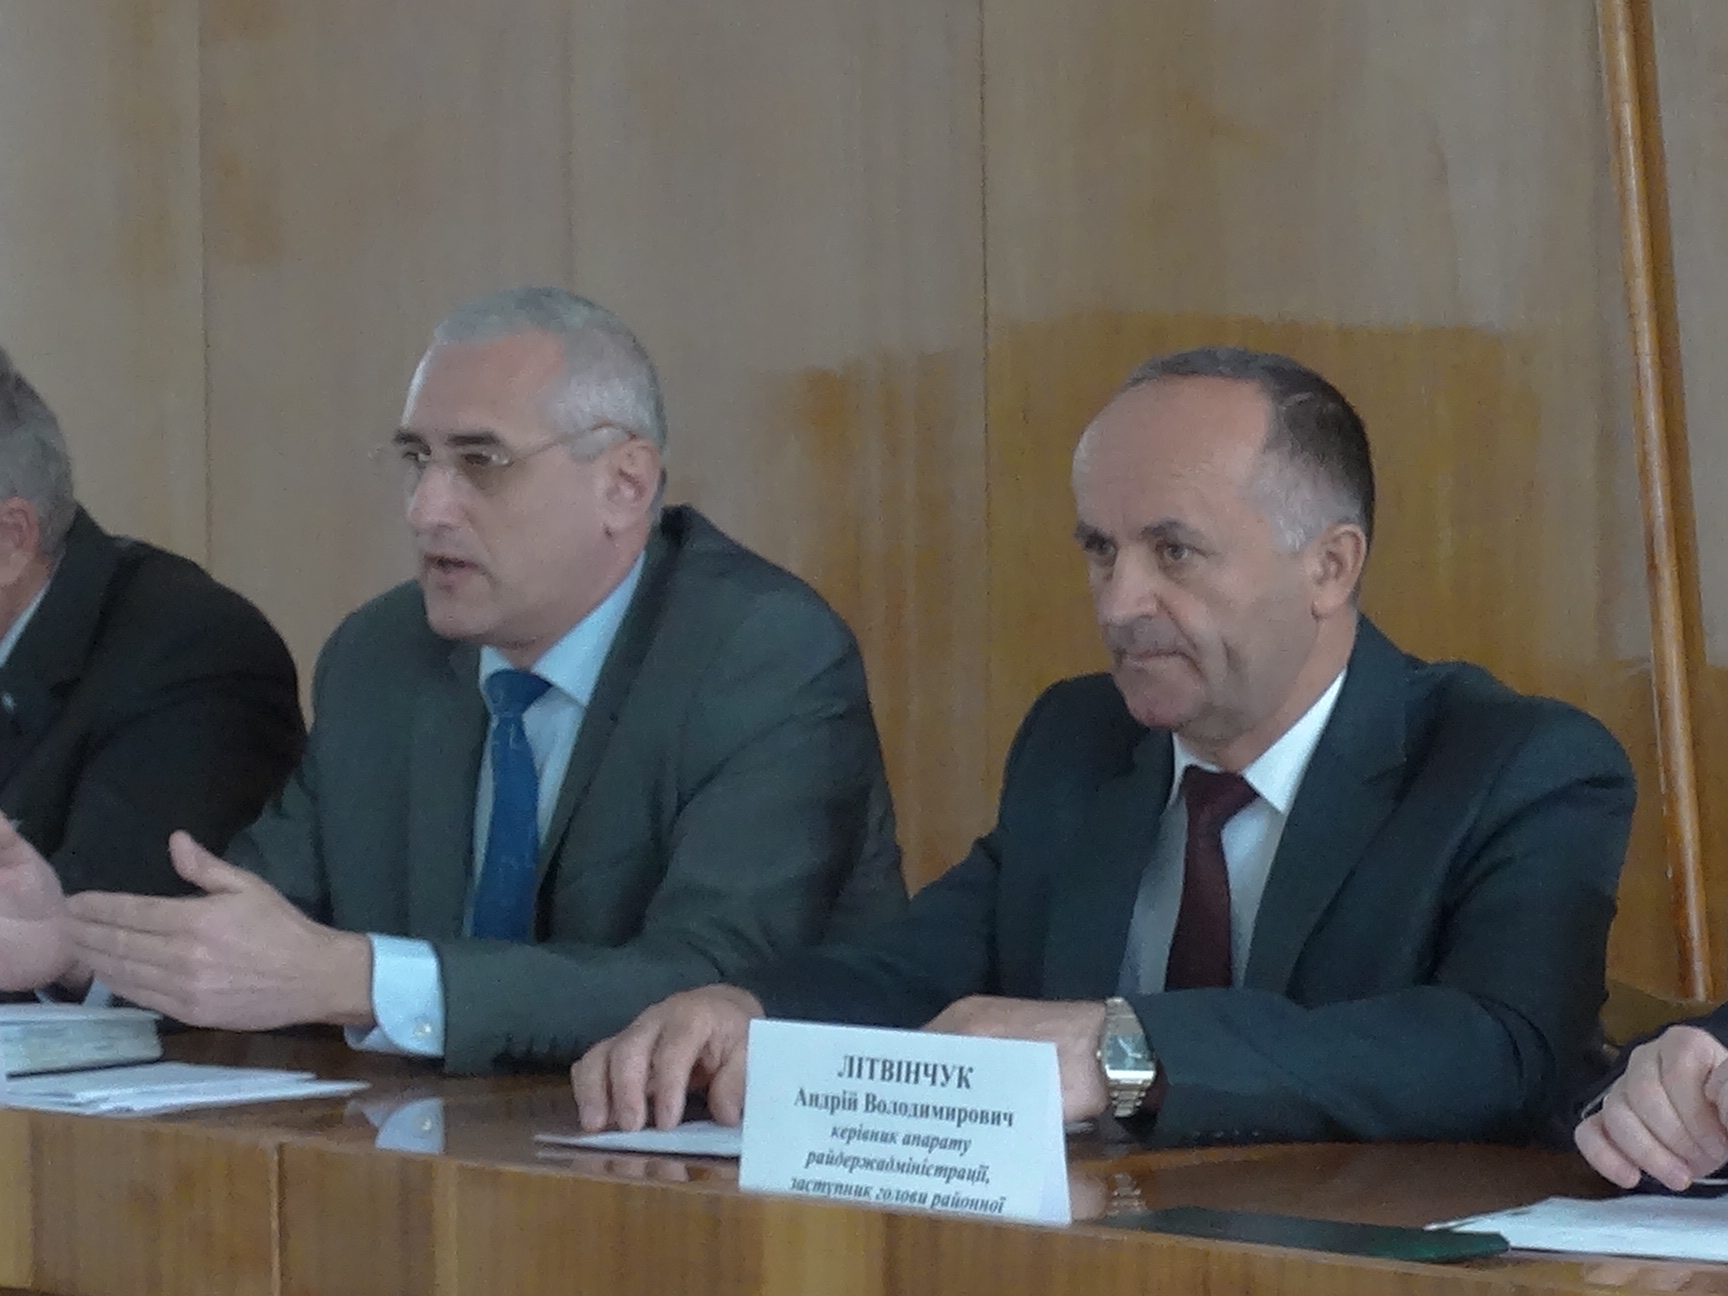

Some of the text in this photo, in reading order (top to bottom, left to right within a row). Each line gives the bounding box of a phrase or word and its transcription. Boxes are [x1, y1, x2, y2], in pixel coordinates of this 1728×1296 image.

[837, 1054, 974, 1090] ЛІТВІНЧУК
[793, 1087, 1014, 1128] Андрій Володимирович
[830, 1124, 972, 1156] керівник апарату
[805, 1149, 991, 1185] райдержадміністрації,
[790, 1176, 1007, 1215] заступник голови районної
